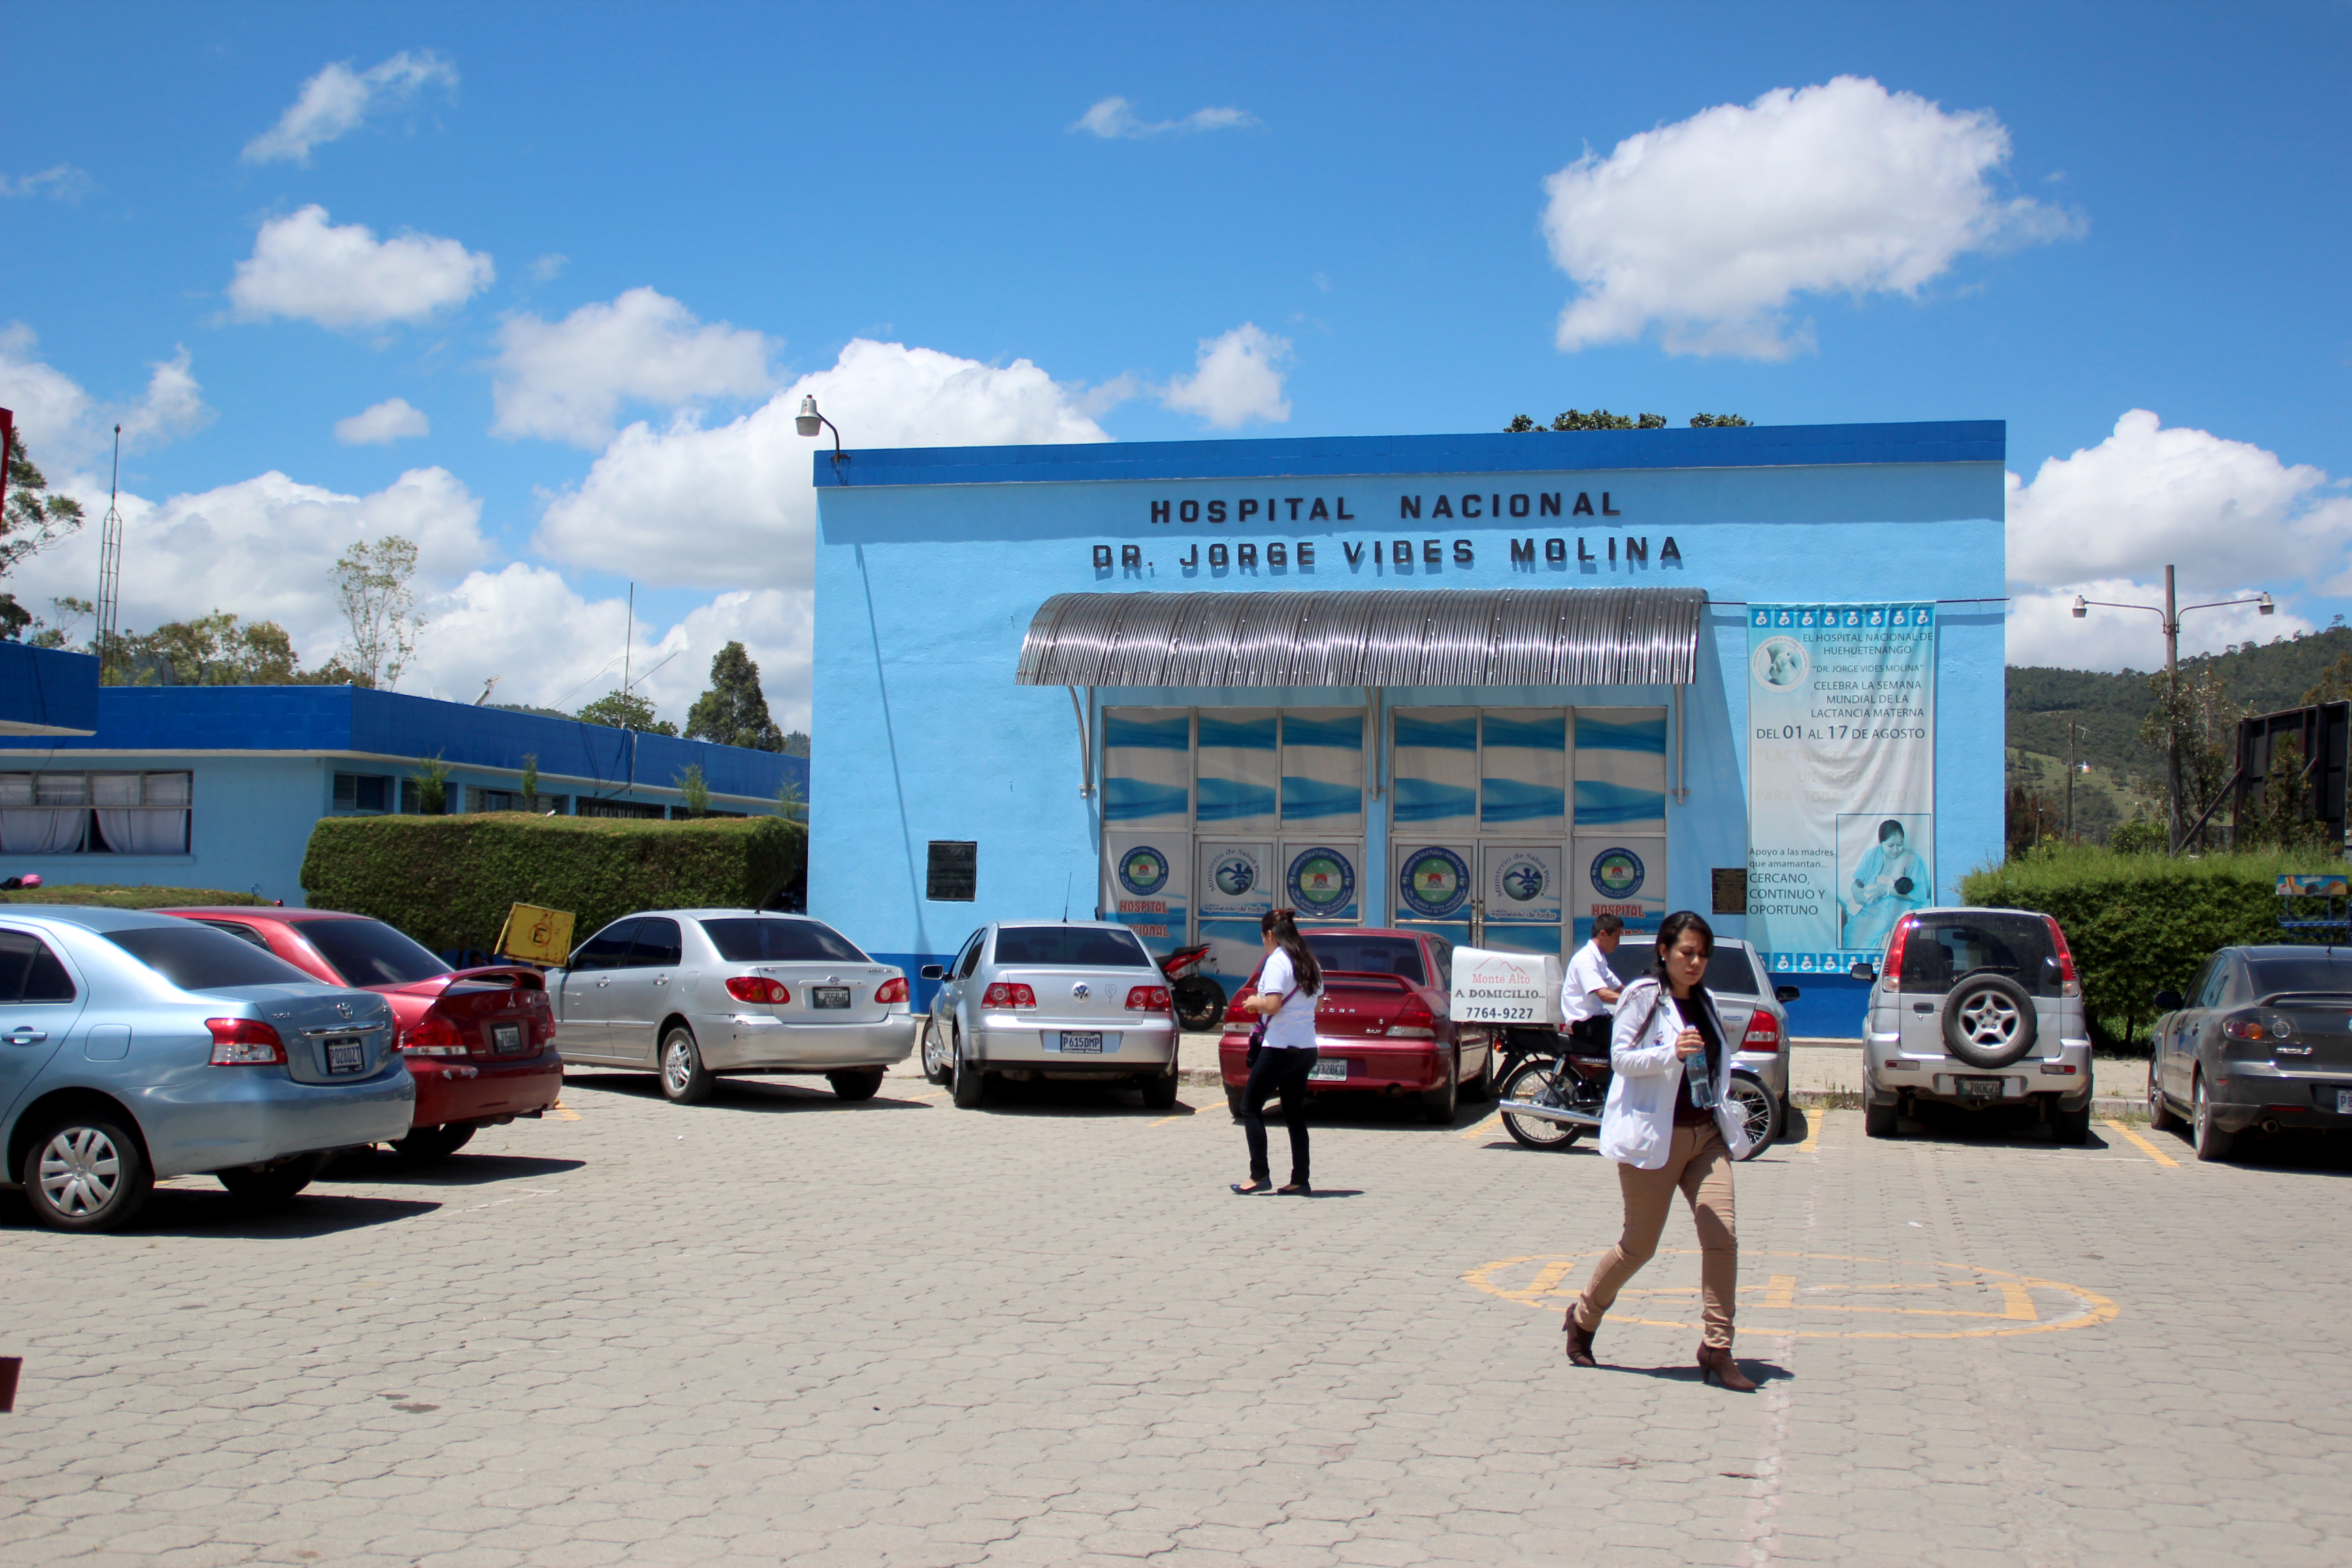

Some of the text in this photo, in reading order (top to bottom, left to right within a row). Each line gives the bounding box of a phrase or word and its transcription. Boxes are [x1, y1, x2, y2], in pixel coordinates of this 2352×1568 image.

[1150, 491, 1620, 523] HOSPITAL NACIONAL
[1093, 536, 1682, 570] DR. JORGE VIDES MOLINA
[1803, 632, 1933, 642] EL HOSPITAL NACIONAL DE
[1823, 646, 1912, 655] HUEHUETENANGO
[1831, 665, 1858, 673] JORGE
[1860, 665, 1884, 673] VIDES
[1814, 681, 1922, 690] CELEBRA LA SEMANA
[1827, 694, 1908, 704] MUNDIAL DE LA
[1811, 708, 1924, 718] LACTANCIA MATERNA
[1757, 725, 1925, 739] DEL 01 AL 17 DE AGOSTO
[1749, 847, 1778, 858] Apoyo
[1786, 847, 1799, 856] las
[1801, 848, 1834, 856] madres
[1749, 860, 1828, 870] que amamantan...
[1207, 853, 1224, 892] Ministerio
[1238, 849, 1257, 864] Salud
[1493, 858, 1512, 898] Ministerio
[1526, 853, 1546, 870] Salud
[1749, 873, 1811, 885] CERCANO,
[1749, 889, 1825, 899] CONTINUO Y
[1120, 900, 1169, 913] HOSPITAL
[1247, 904, 1266, 913] todos
[1591, 904, 1645, 917] HOSPITAL
[1749, 904, 1818, 915] OPORTUNO
[1526, 911, 1535, 919] de
[1472, 974, 1531, 984] Monte Alto
[1454, 989, 1465, 998] A
[1465, 1007, 1533, 1019] 7764-9227
[1063, 1037, 1100, 1048] P615DMP
